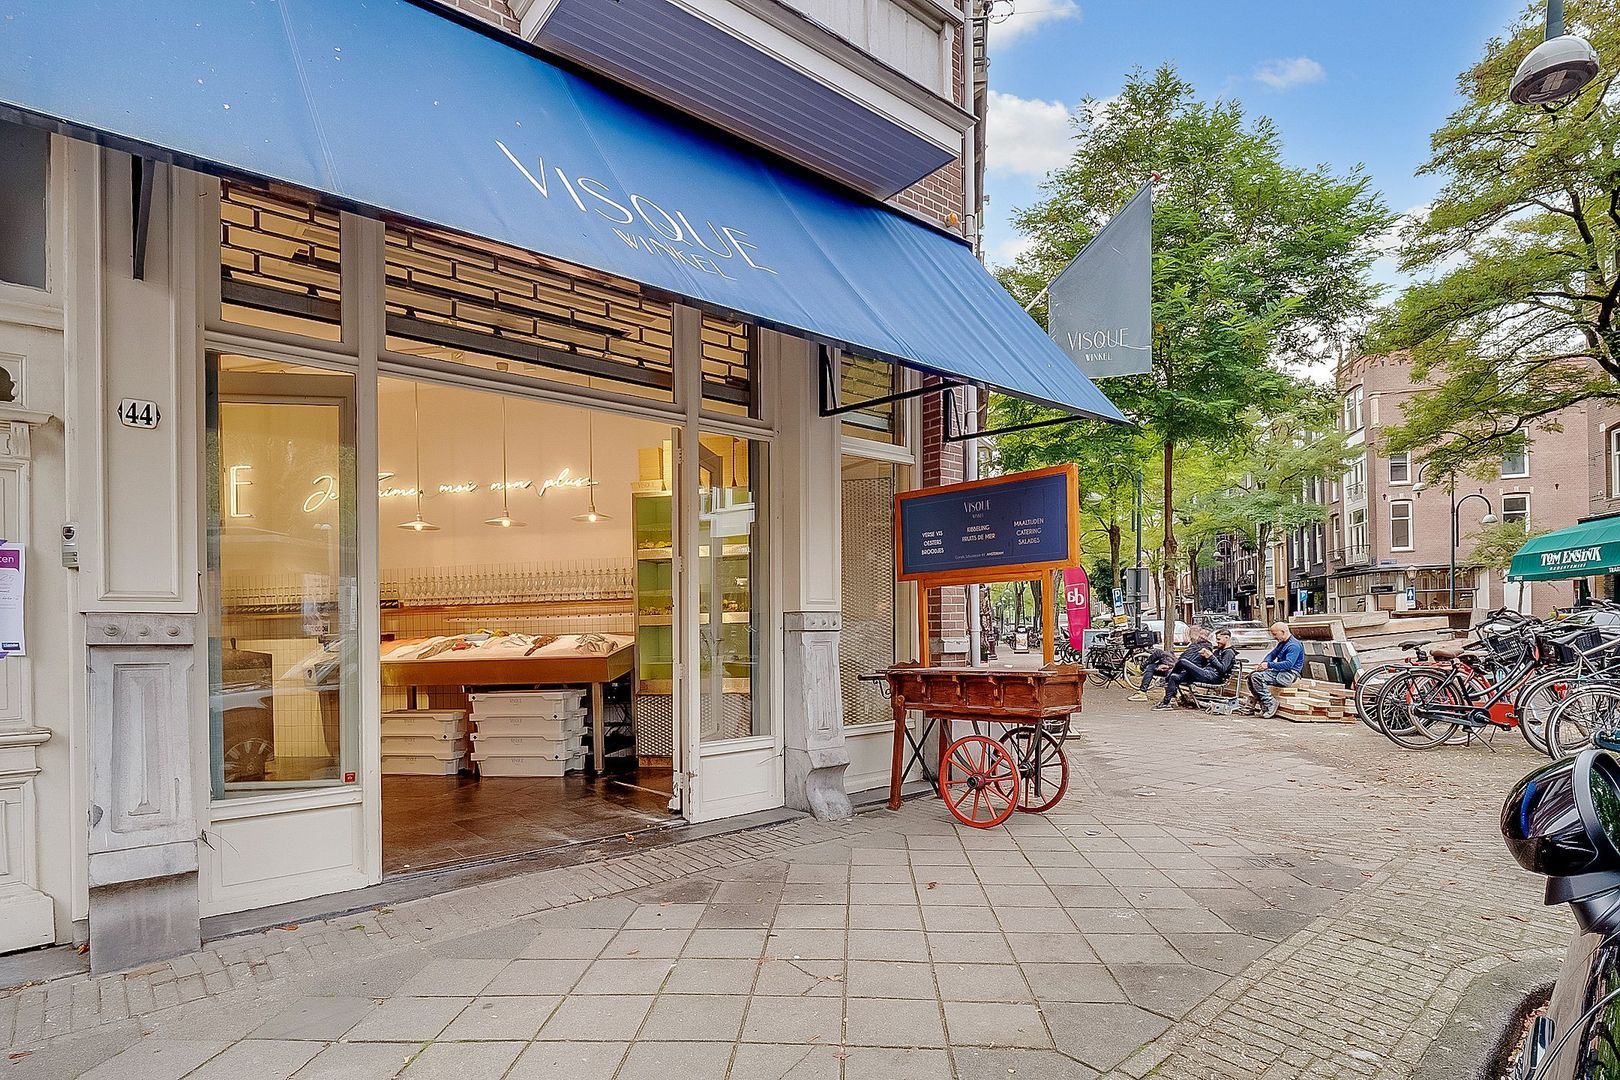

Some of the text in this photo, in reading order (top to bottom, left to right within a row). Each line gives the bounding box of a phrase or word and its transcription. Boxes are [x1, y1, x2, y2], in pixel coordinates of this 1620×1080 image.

[495, 138, 778, 275] VISQUE
[611, 227, 737, 281] WINKEL
[1067, 327, 1129, 351] VISQUE
[1084, 352, 1113, 362] WINKEL
[124, 401, 154, 426] 44
[438, 481, 478, 494] moi
[963, 499, 992, 513] VISQUE
[966, 524, 991, 533] KIBBELING
[1015, 527, 1042, 536] CATERING
[961, 534, 977, 542] FRUITS
[984, 532, 996, 540] MER
[1018, 536, 1041, 546] SALADES
[921, 547, 945, 556] BROODJES
[1540, 551, 1562, 567] TOM
